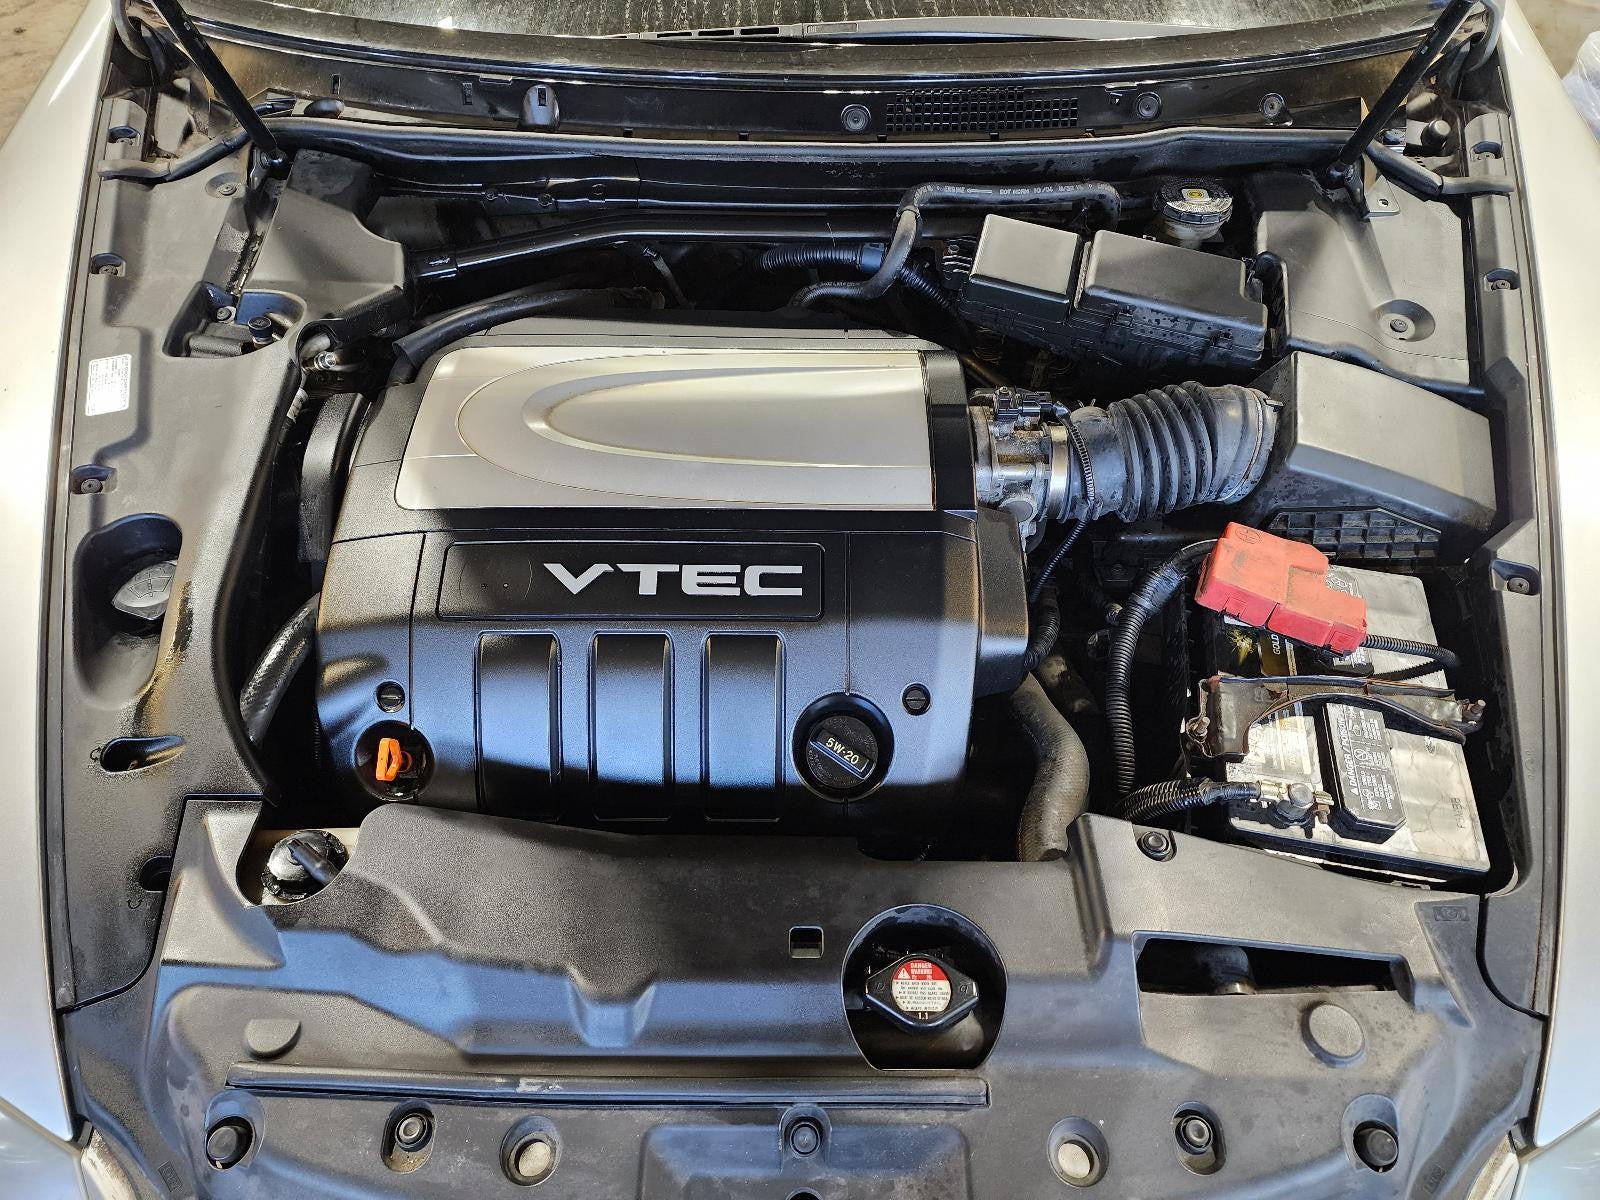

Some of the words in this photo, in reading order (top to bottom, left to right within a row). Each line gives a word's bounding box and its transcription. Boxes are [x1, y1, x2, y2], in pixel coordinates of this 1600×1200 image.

[543, 563, 803, 596] VTEC
[1271, 633, 1281, 655] GOLD
[825, 737, 860, 765] 5W-20
[917, 1012, 929, 1020] 1.1
